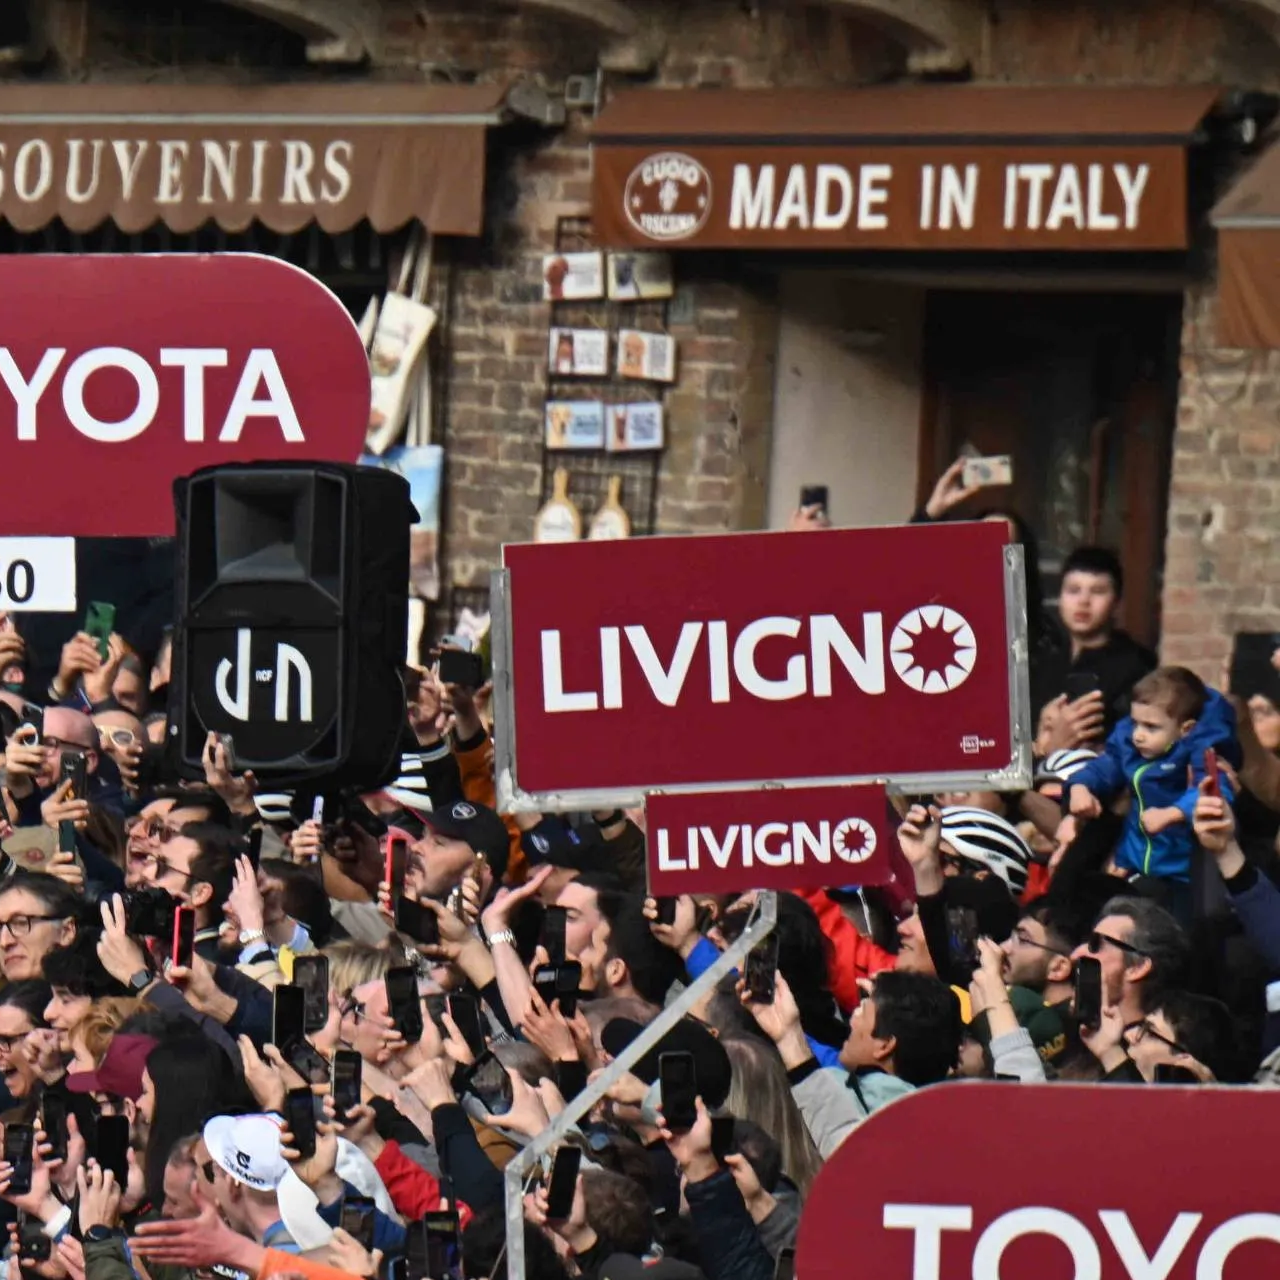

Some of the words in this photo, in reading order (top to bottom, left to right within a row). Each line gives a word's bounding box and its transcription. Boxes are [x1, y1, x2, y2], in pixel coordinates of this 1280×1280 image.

[728, 161, 893, 231] MADE
[918, 162, 979, 230] IN
[1003, 162, 1151, 231] ITALY
[540, 603, 978, 713] LIVIGNO
[656, 816, 878, 872] LIVIGNO
